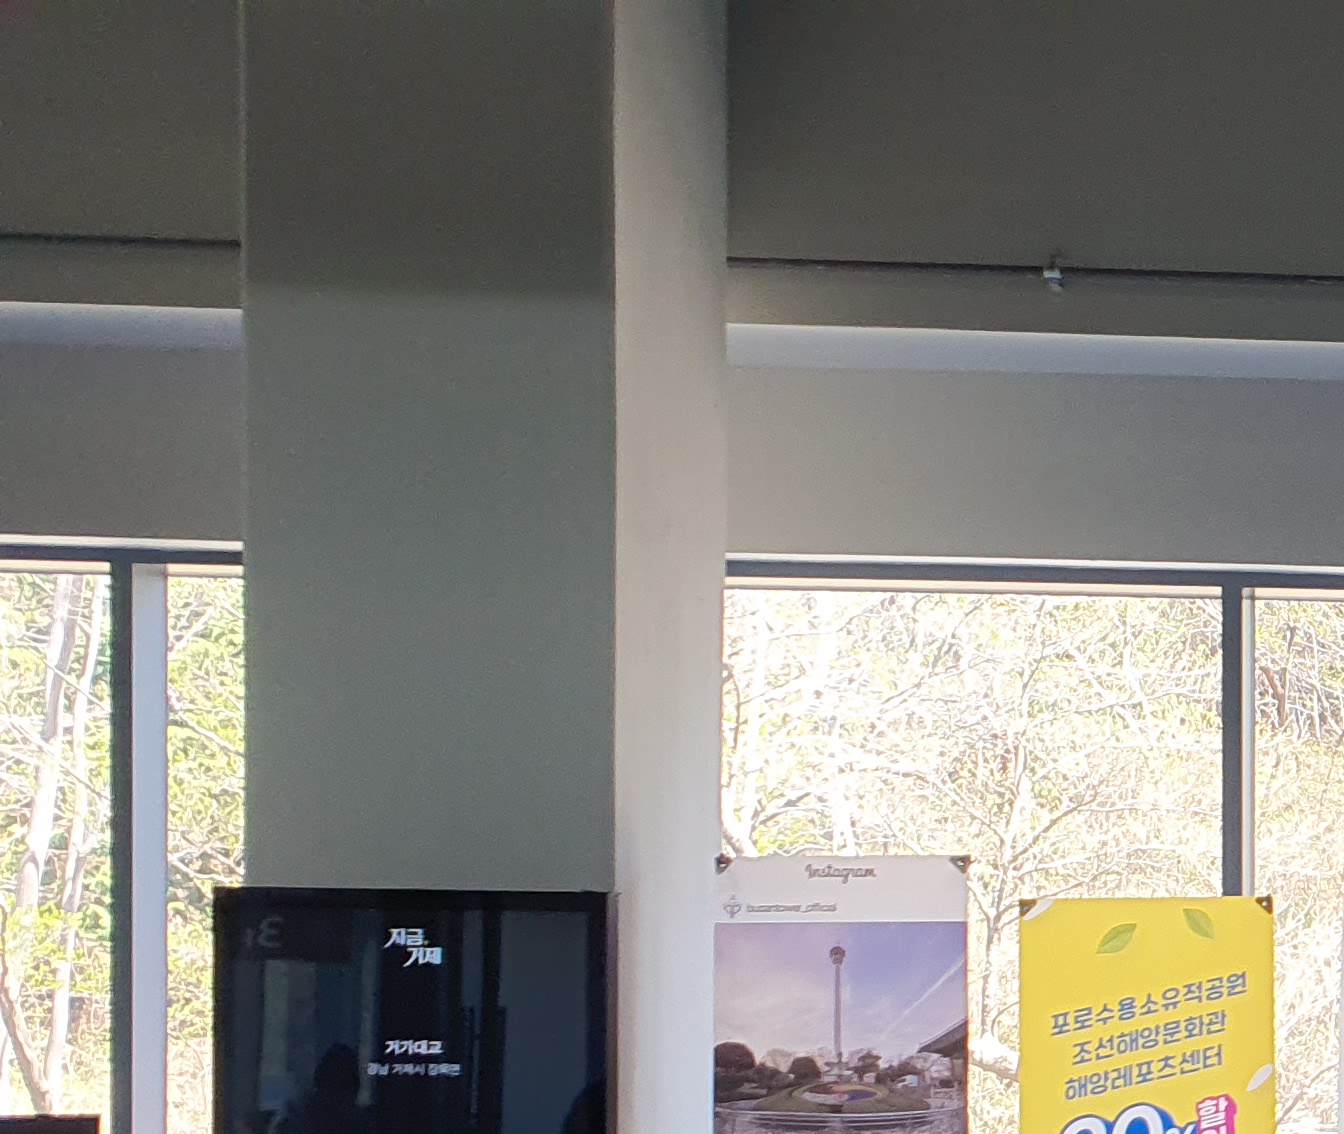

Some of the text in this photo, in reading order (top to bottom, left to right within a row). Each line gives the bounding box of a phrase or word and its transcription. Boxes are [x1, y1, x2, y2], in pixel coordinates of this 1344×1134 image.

[805, 863, 877, 885] Instagram
[403, 947, 442, 967] 거제
[1050, 970, 1249, 1038] 포로수용소유적공원
[385, 1040, 443, 1055] 거가대교
[1072, 1009, 1228, 1066] 조선해양문화관
[1064, 1043, 1224, 1101] 해양레포츠센터
